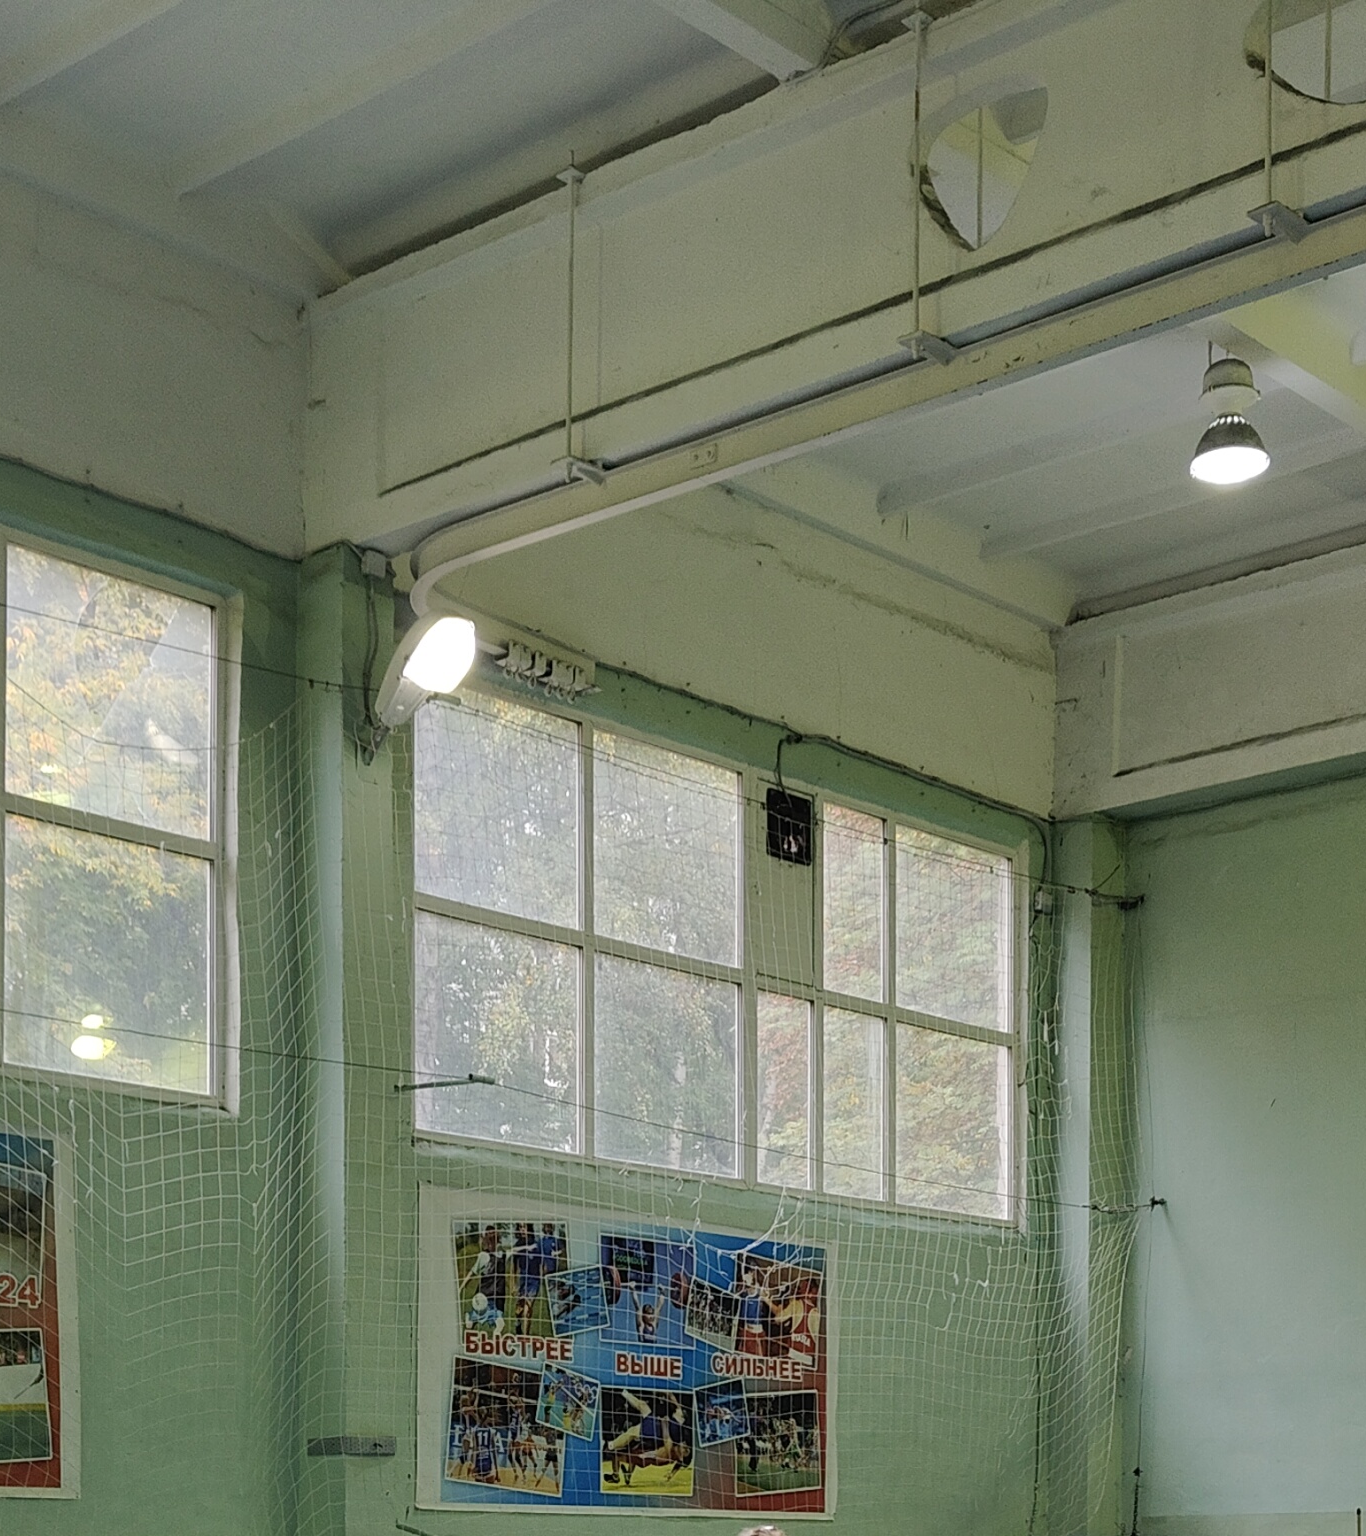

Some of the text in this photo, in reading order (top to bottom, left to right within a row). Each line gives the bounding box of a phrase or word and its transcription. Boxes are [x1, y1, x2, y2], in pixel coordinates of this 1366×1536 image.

[465, 1330, 573, 1362] БЫСТРЕЕ
[615, 1352, 802, 1382] ВЫШЕ СИЛЬНЕЕ
